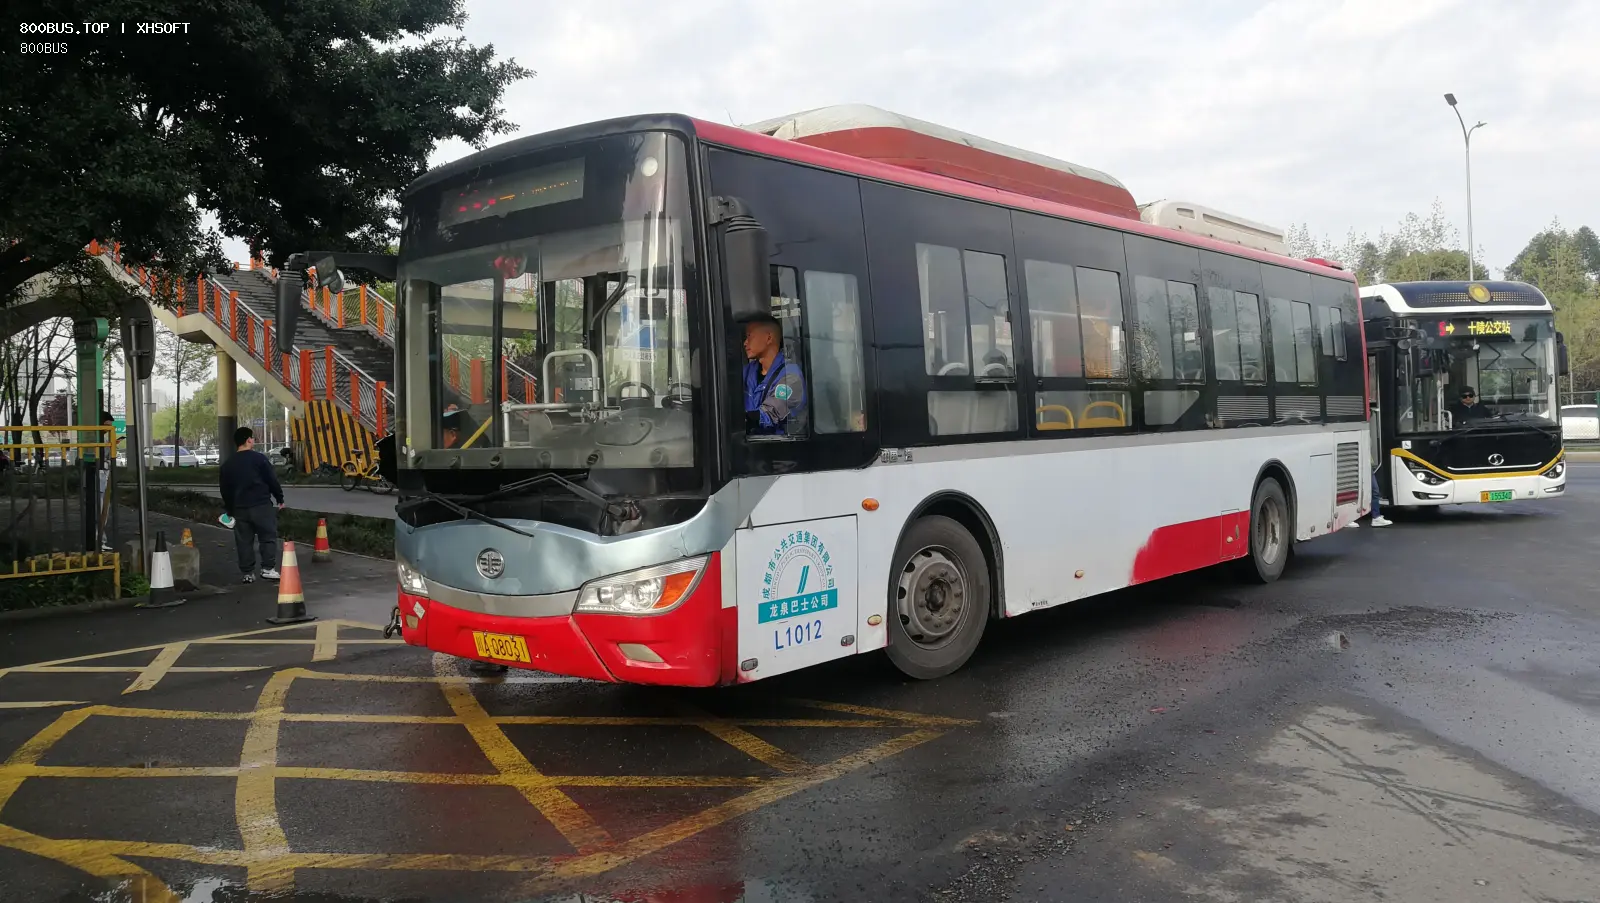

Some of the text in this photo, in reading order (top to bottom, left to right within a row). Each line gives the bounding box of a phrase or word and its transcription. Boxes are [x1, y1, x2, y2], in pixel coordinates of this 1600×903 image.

[1468, 320, 1511, 335] 十陵公交站
[762, 530, 835, 600] 成都市公共交通集团有限公司
[769, 593, 829, 618] 龙泉巴士公司
[774, 620, 822, 650] L1012
